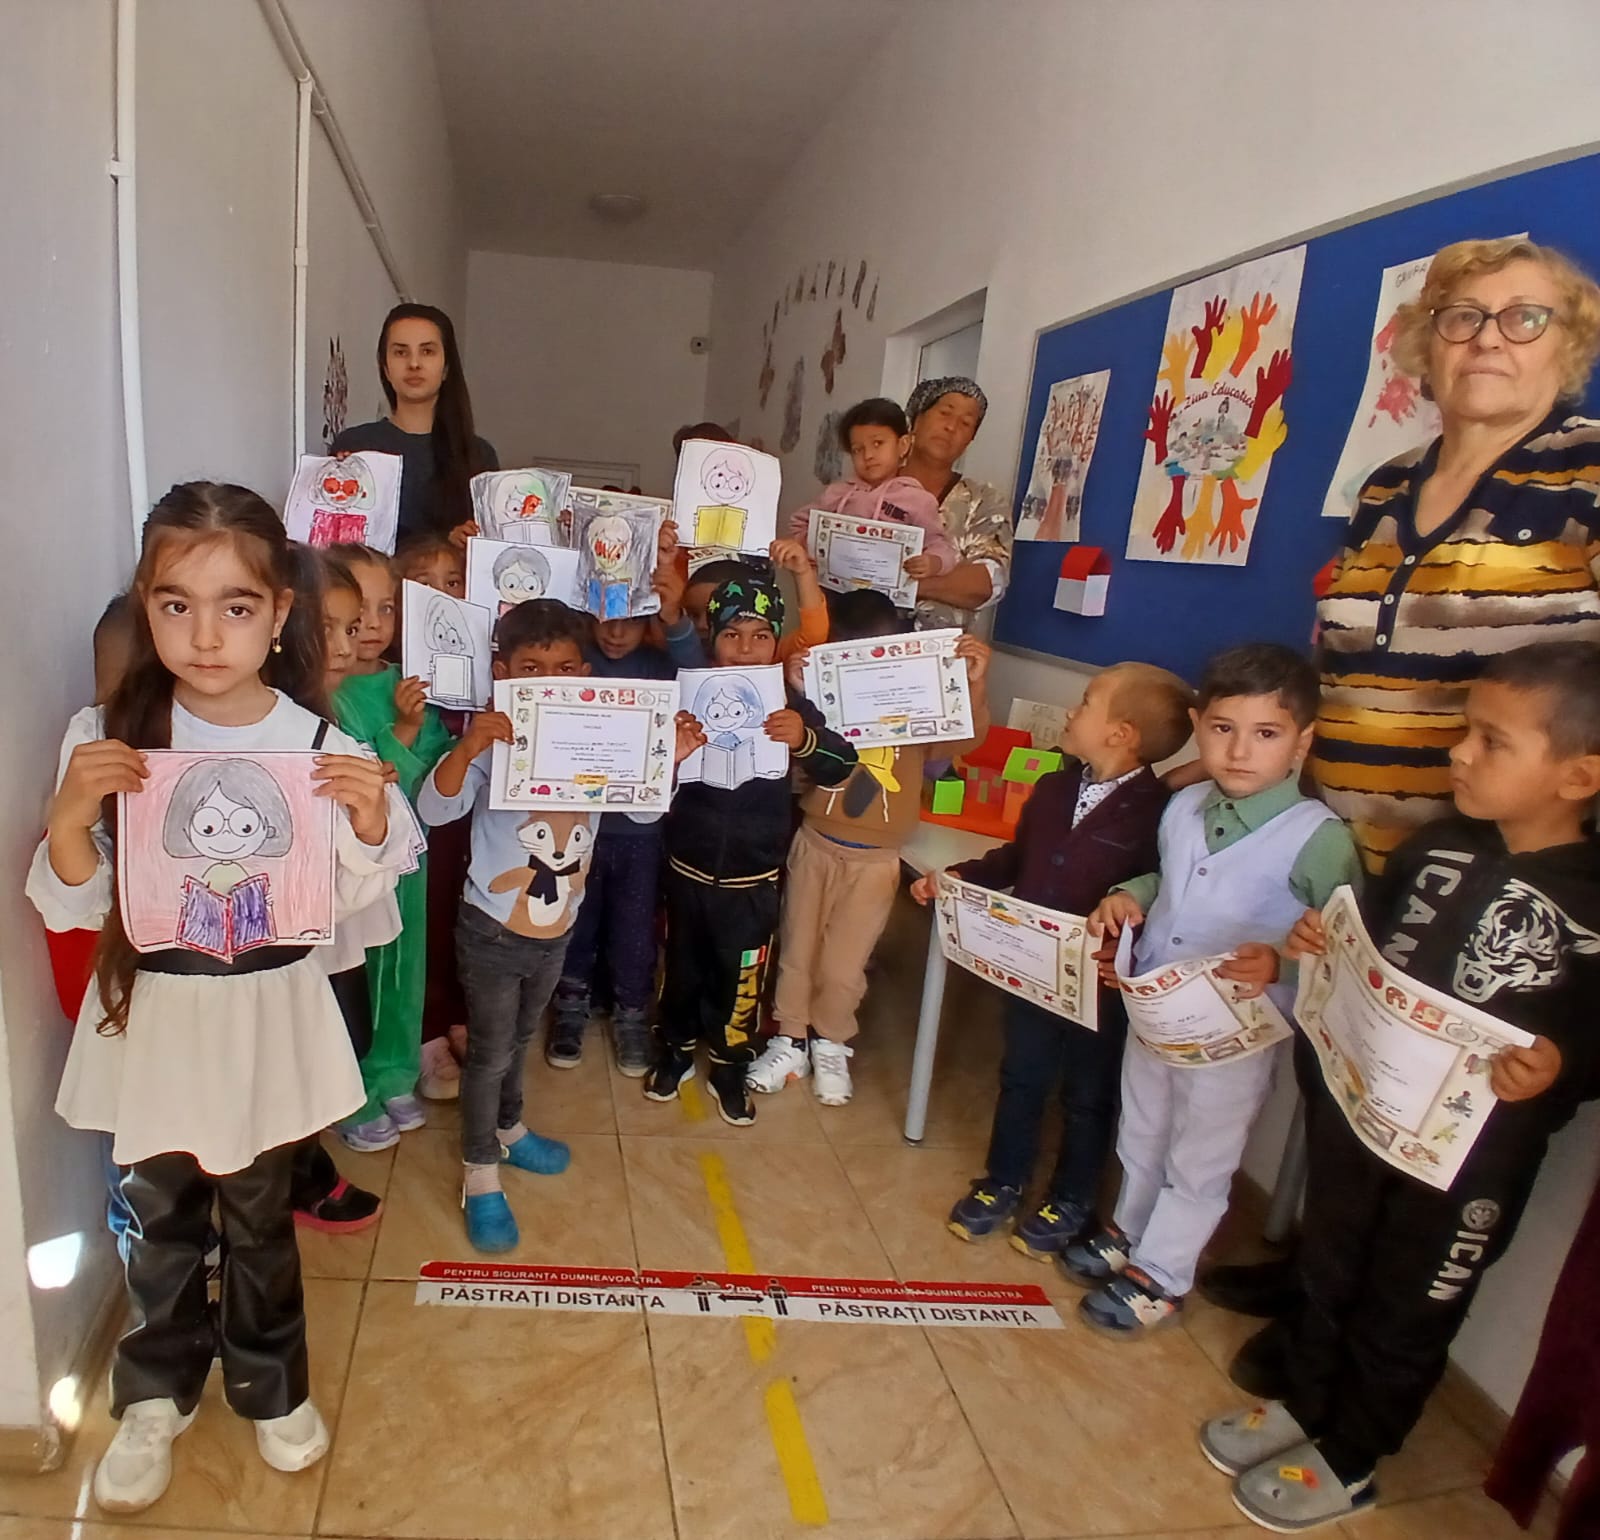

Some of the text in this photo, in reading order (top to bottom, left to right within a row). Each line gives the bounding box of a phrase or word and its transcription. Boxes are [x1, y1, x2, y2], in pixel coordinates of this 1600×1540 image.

[443, 1268, 489, 1277] PENTRU
[440, 1285, 550, 1307] PĂSTRAȚI
[811, 1284, 857, 1295] PENTRU
[819, 1301, 1038, 1326] PĂSTRAȚI DISTANȚA
